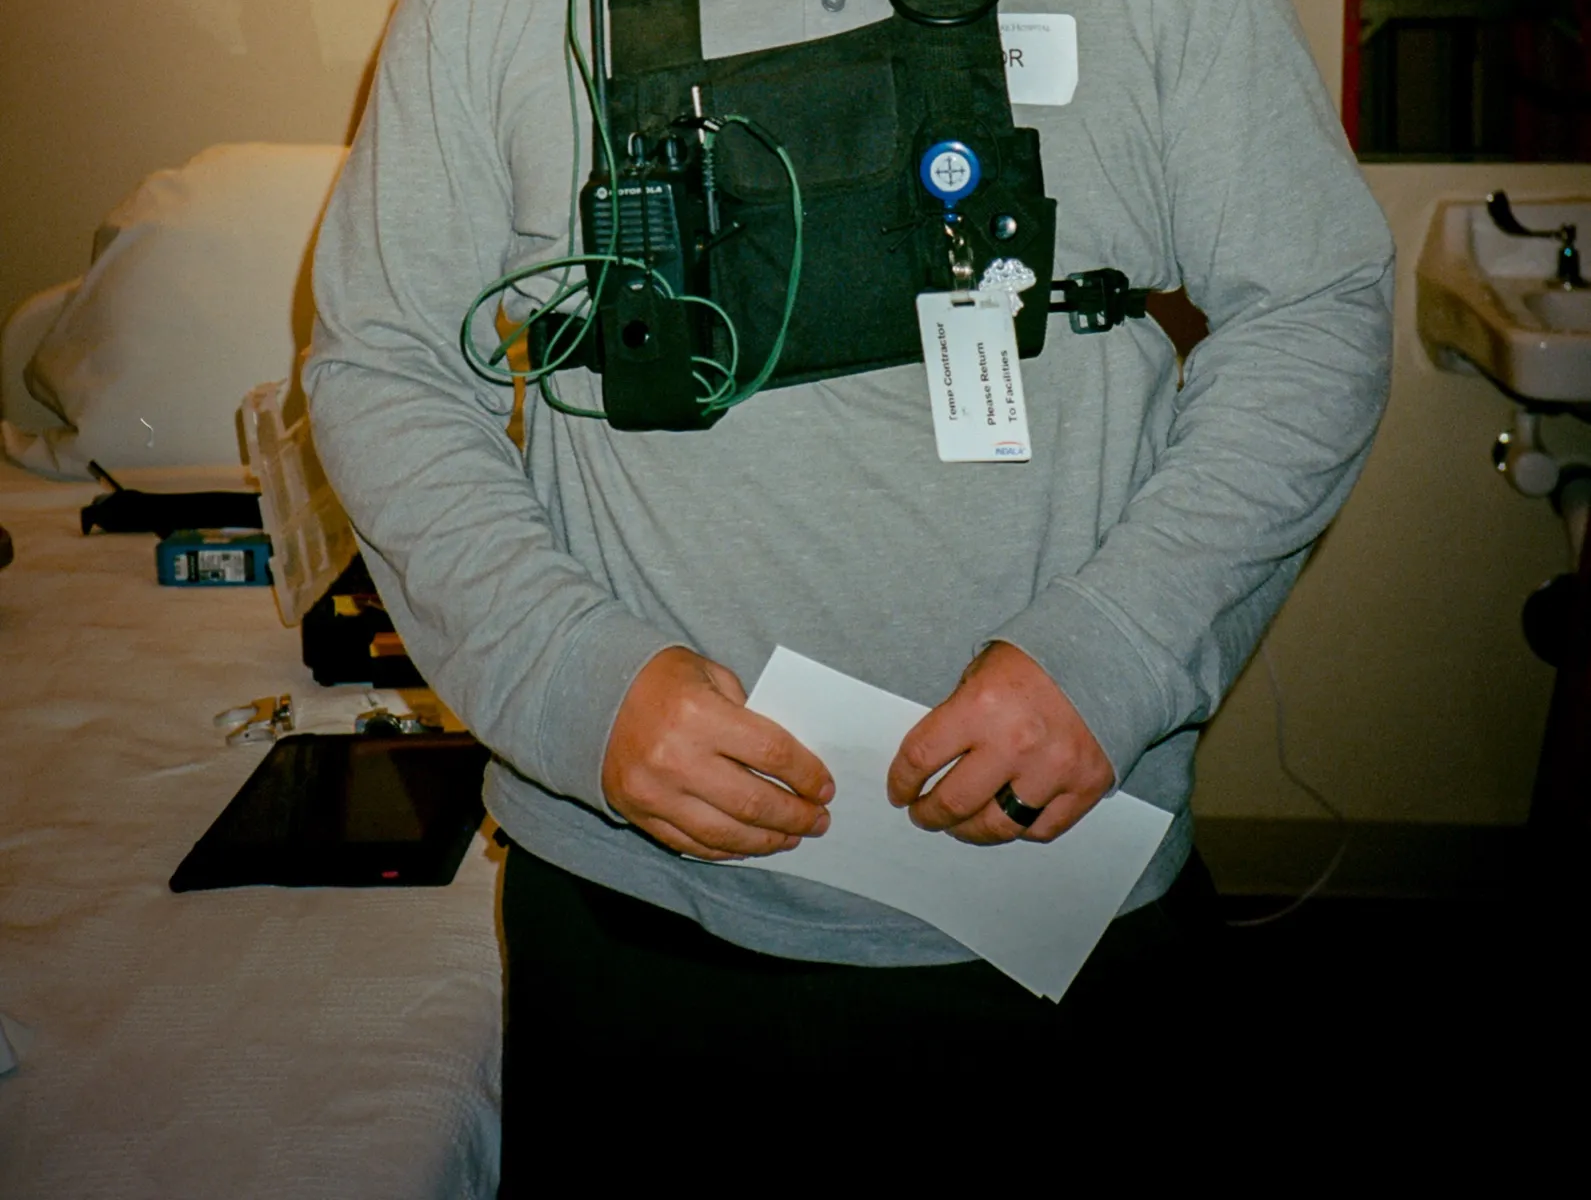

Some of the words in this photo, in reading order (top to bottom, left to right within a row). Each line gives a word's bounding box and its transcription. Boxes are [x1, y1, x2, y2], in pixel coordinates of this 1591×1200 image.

[937, 322, 952, 386] Contractor
[977, 342, 990, 382] Return
[1001, 350, 1016, 404] Facilities
[984, 386, 997, 426] Please
[1008, 407, 1017, 423] To
